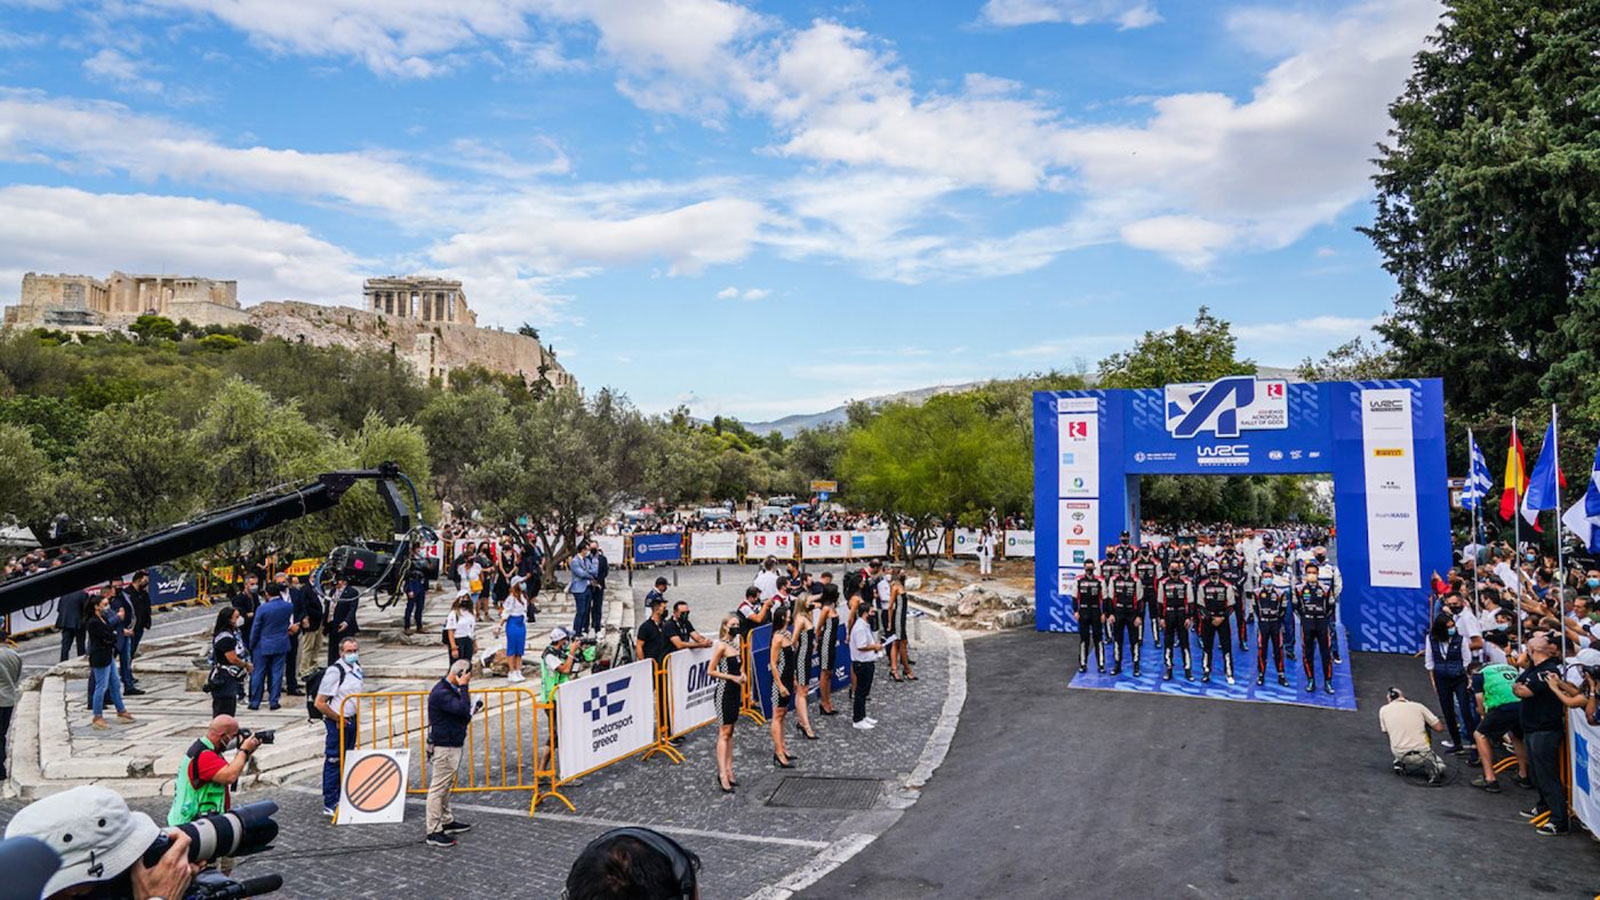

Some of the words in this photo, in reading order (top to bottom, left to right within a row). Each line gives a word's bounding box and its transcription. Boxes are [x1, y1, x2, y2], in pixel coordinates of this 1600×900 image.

[1369, 400, 1403, 408] WRC
[1197, 444, 1249, 457] WRC
[592, 714, 633, 738] motorsport
[592, 733, 618, 752] greece
